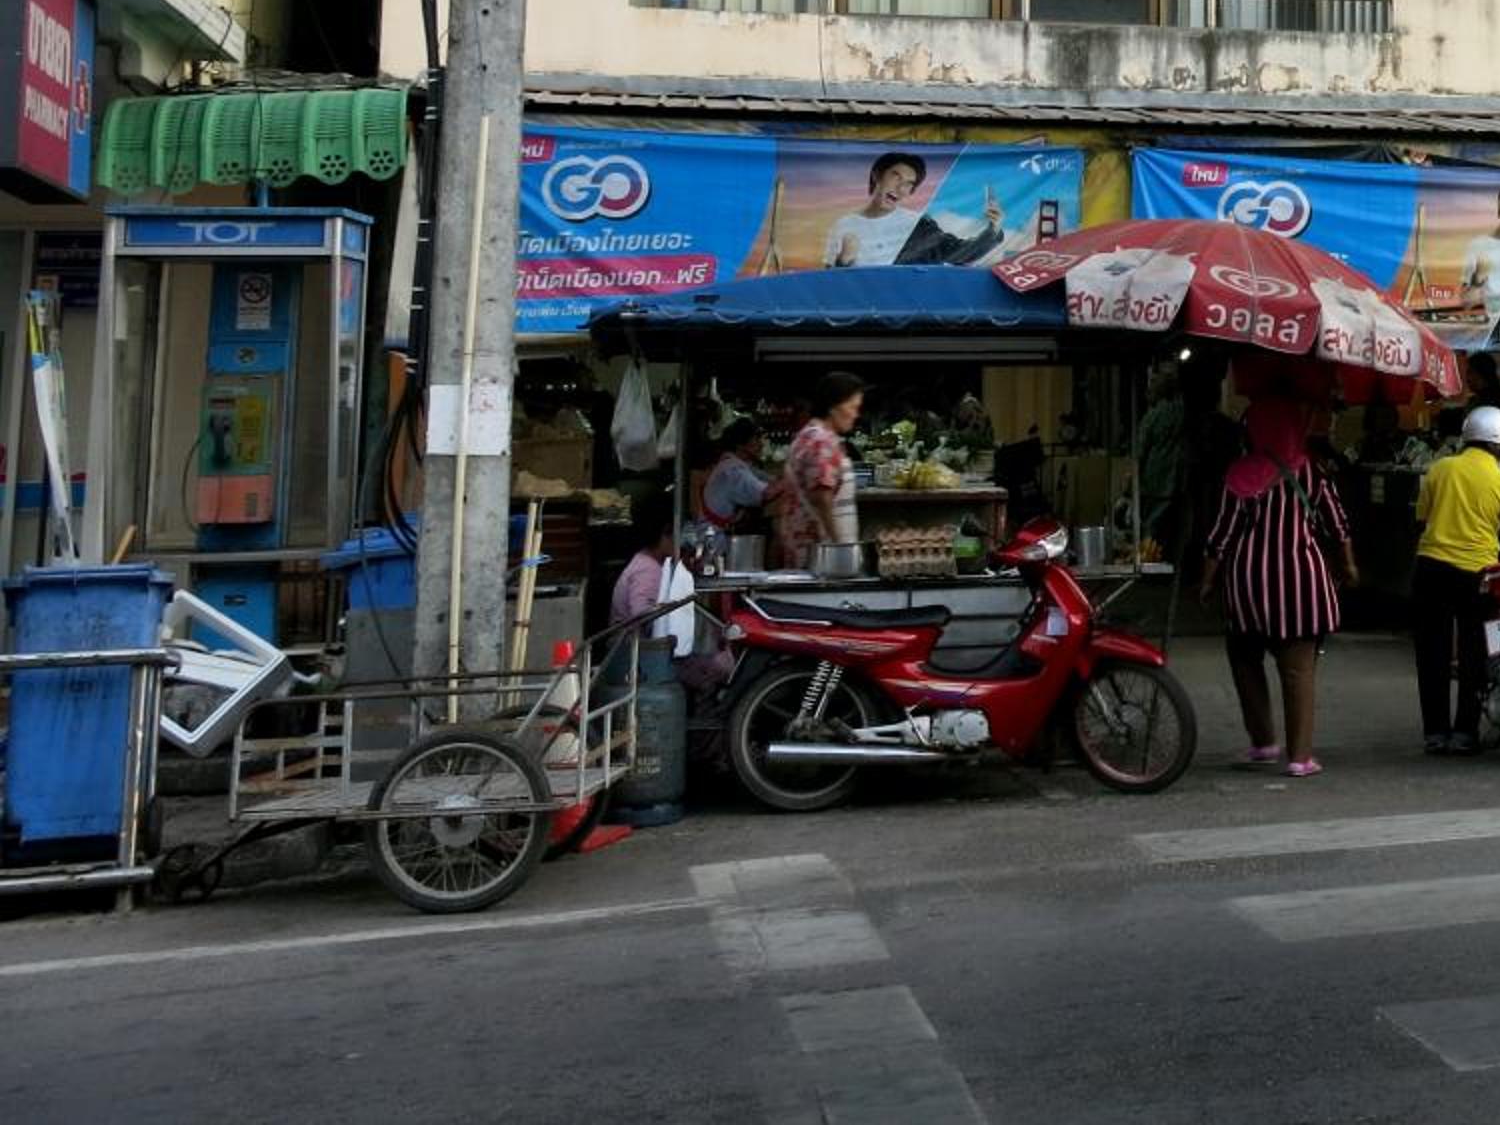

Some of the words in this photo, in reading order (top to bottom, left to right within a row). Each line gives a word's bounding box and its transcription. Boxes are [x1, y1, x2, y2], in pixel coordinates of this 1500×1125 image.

[24, 85, 69, 141] PHARMACY
[542, 154, 650, 220] GO
[177, 221, 277, 243] TOT
[1206, 303, 1305, 344] วอลล์
